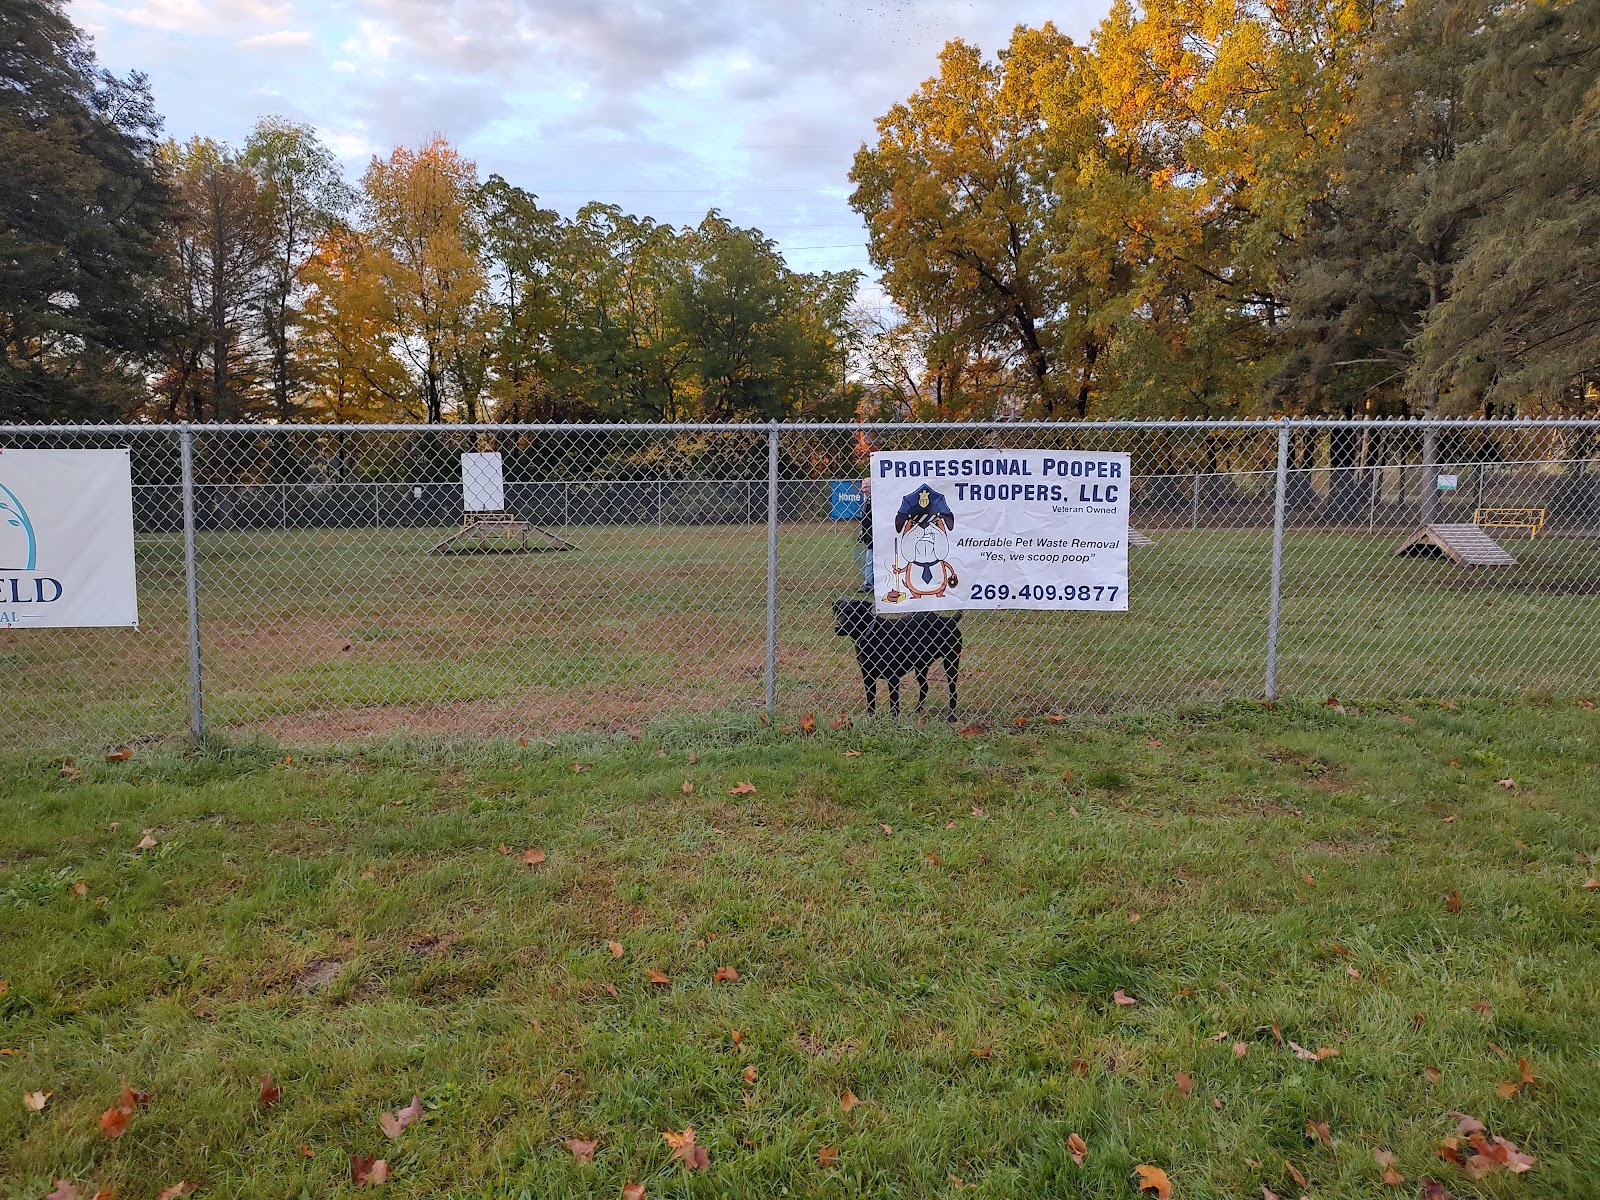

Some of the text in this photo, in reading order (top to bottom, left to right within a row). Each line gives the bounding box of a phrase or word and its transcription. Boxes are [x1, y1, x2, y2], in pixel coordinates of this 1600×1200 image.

[880, 458, 1122, 478] PROFESSIONAL POOPER
[838, 493, 861, 501] Home
[955, 483, 1118, 503] TROOPERS, LLC
[1052, 505, 1117, 514] Veteran Owned
[957, 538, 1119, 549] Affordable Pet Waste Removal
[980, 551, 1006, 561] “Yes,
[1027, 554, 1059, 564] scoop
[1061, 553, 1096, 564] poop”
[970, 584, 1119, 602] 269.409.9877
